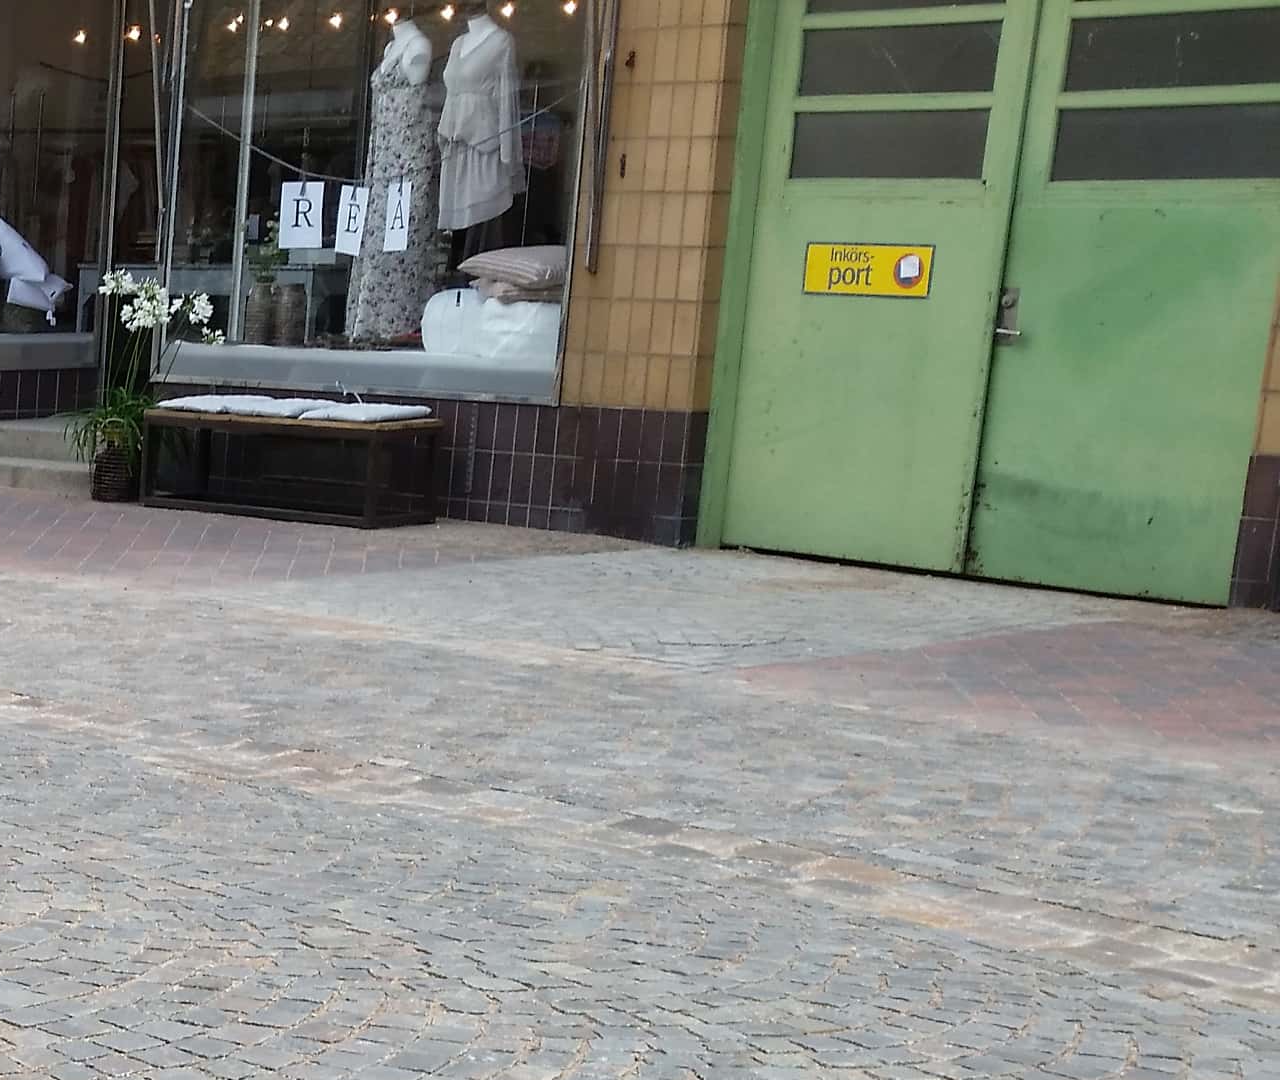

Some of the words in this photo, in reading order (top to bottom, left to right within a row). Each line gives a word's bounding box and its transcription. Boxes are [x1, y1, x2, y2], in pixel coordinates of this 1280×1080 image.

[291, 198, 404, 234] REA
[830, 247, 875, 263] Inkörs-
[828, 264, 873, 290] port
